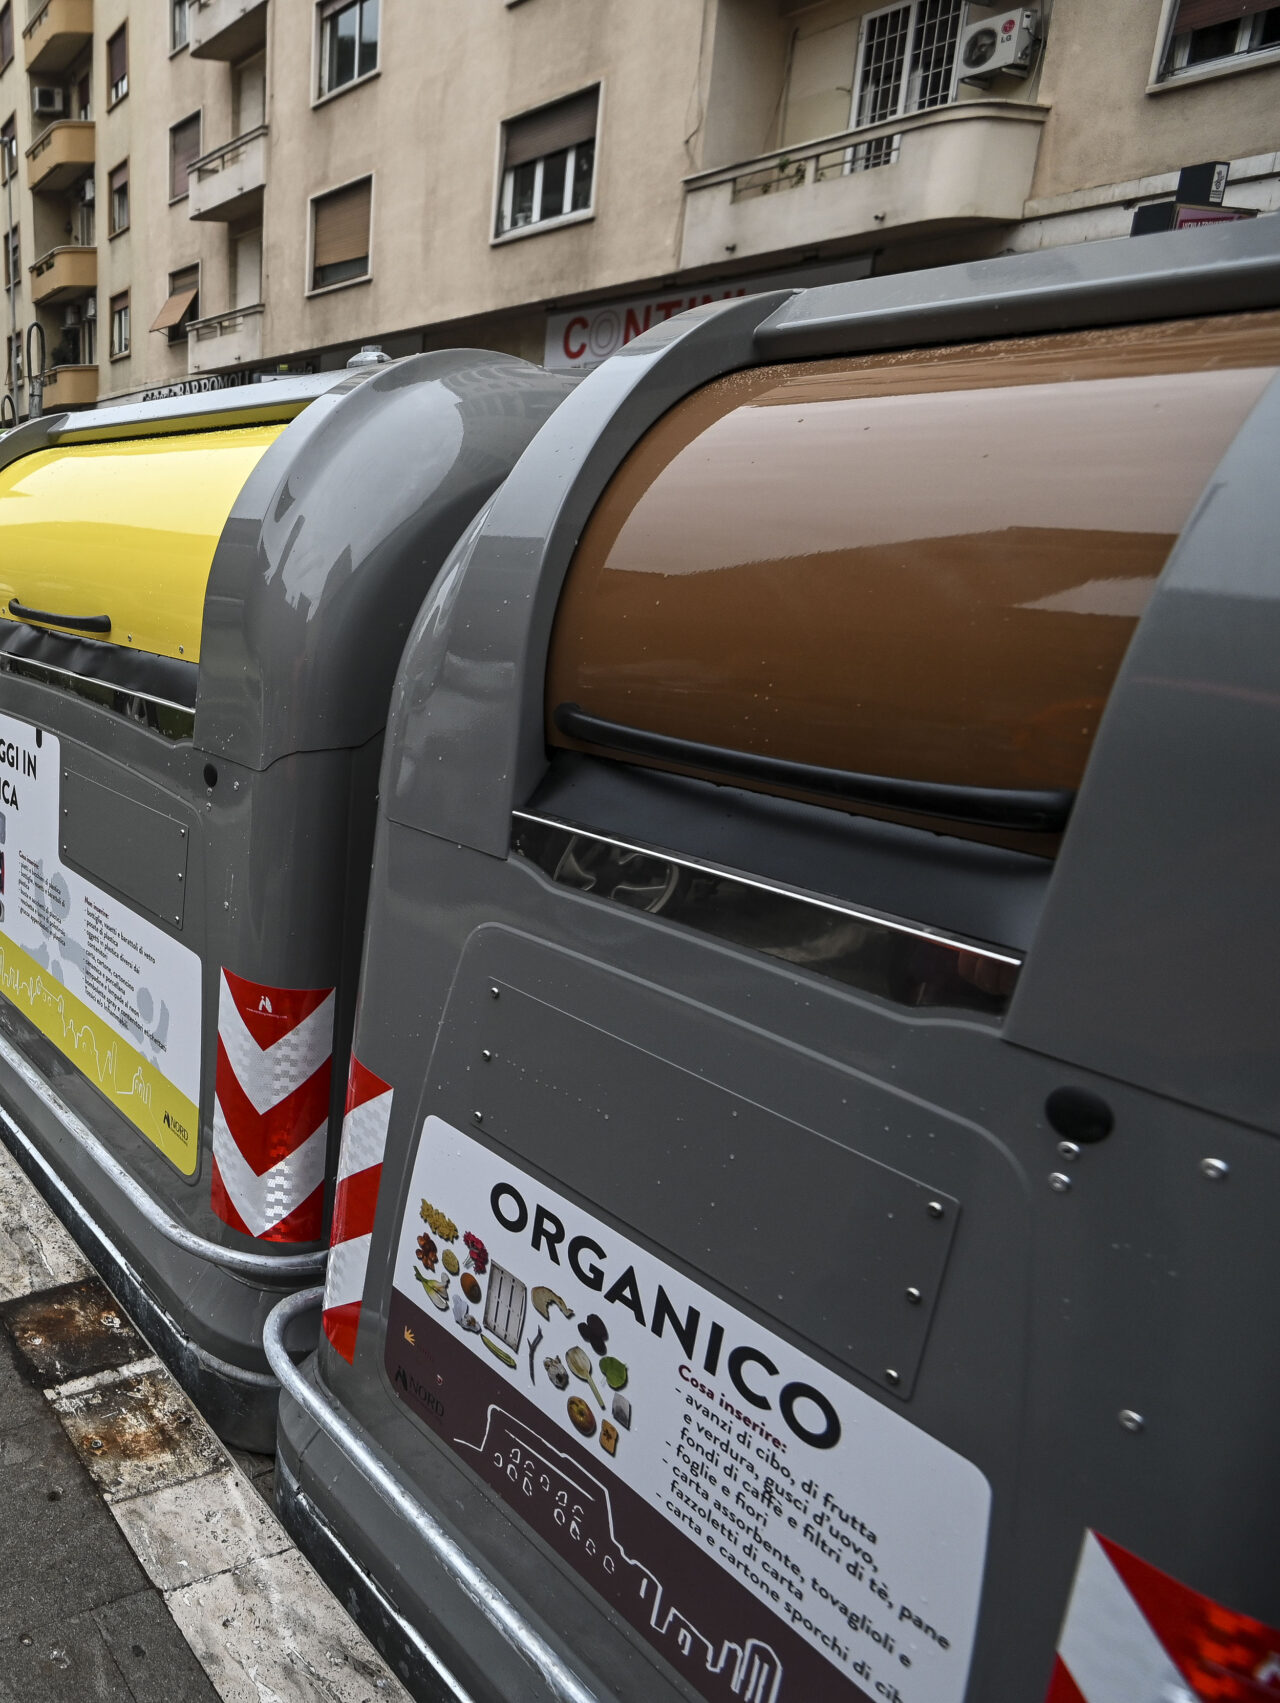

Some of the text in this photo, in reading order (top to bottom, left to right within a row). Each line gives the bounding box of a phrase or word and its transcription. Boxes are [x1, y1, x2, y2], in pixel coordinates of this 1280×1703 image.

[1001, 35, 1012, 43] LG
[563, 288, 746, 359] CONT
[23, 750, 36, 781] IN
[490, 1182, 841, 1450] ORGANICO
[678, 1364, 786, 1453] Cosa inserire:
[683, 1413, 692, 1424] e
[696, 1422, 759, 1480] verdura,
[763, 1476, 809, 1514] gusci
[676, 1443, 768, 1527] foglie e fiori
[685, 1394, 877, 1544] avanzi di cibo, di frutta
[665, 1500, 702, 1536] carta
[706, 1535, 715, 1546] e
[719, 1546, 780, 1602] cartone
[783, 1601, 849, 1661] sporchi
[852, 1661, 871, 1680] di
[670, 1479, 803, 1601] fazzoletti di carta
[672, 1466, 911, 1667] carta assorbente, tovaglioli e
[680, 1427, 719, 1467] fondi
[723, 1463, 738, 1481] di
[742, 1480, 783, 1517] caffè
[787, 1516, 797, 1528] e
[802, 1523, 842, 1563] filtri
[846, 1561, 864, 1581] di
[898, 1605, 949, 1649] pane
